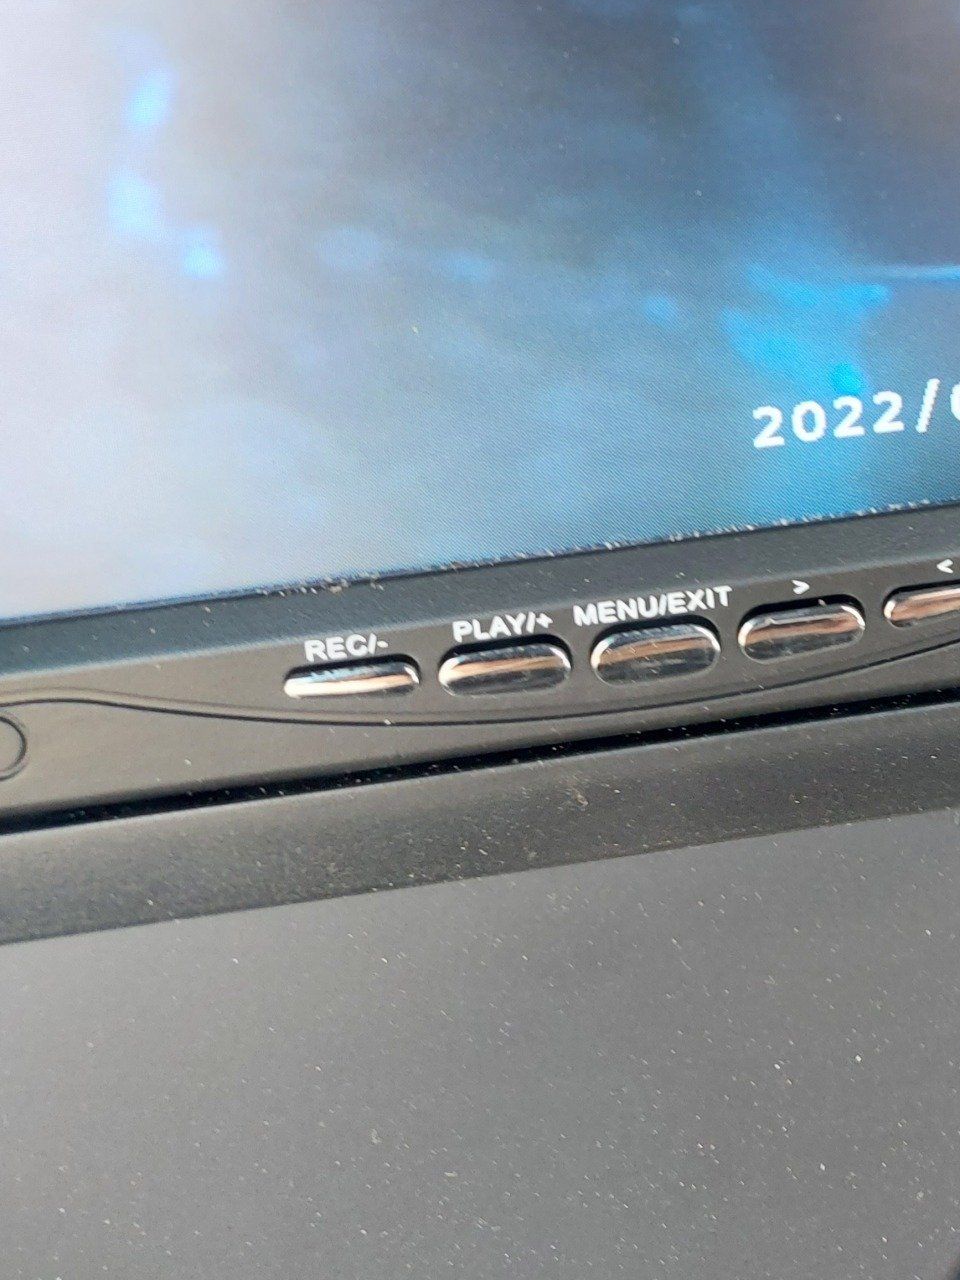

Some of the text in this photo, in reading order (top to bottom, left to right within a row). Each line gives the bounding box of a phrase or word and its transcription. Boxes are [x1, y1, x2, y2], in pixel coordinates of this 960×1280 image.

[572, 584, 733, 628] MENU/EXIT
[451, 612, 554, 643] PLAY/+
[303, 633, 389, 663] REC/-
